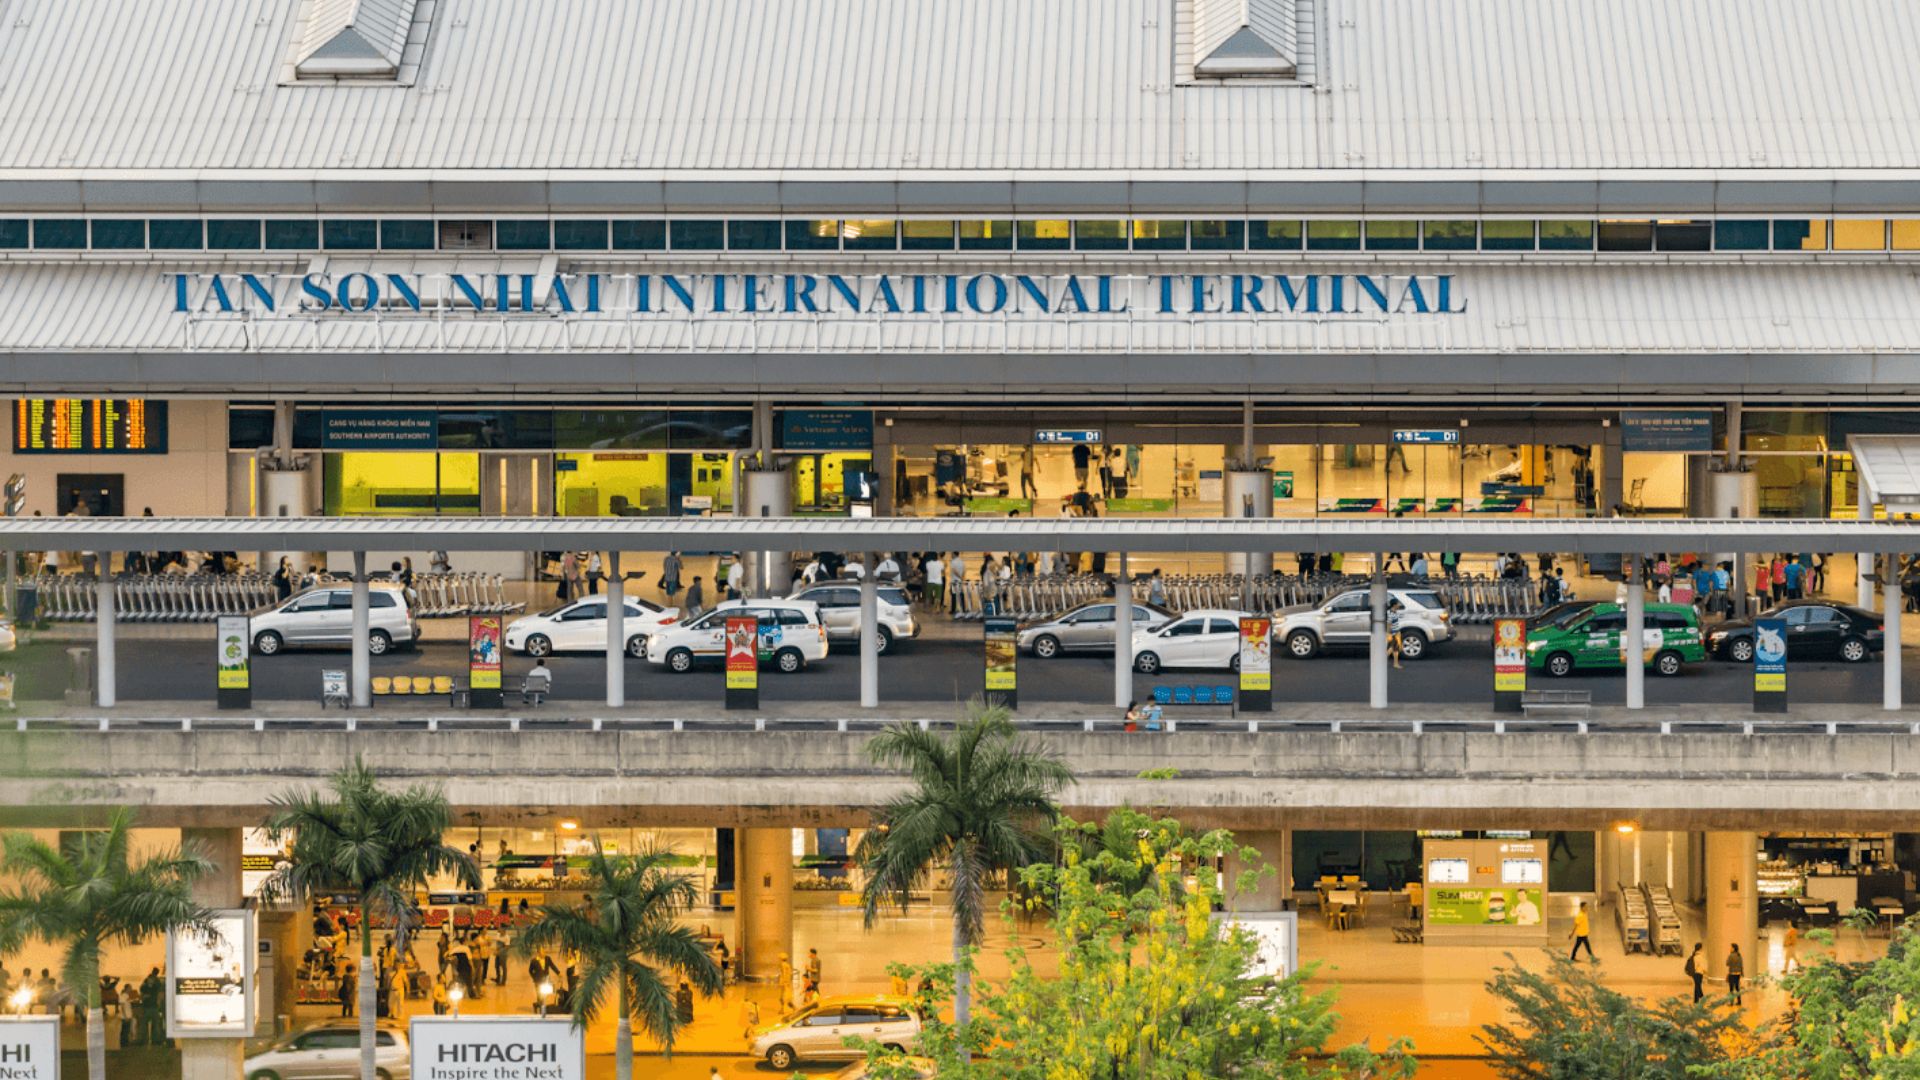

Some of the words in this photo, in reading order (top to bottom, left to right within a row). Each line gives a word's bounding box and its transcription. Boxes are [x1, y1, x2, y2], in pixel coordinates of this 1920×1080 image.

[163, 273, 279, 313] TAN
[302, 272, 424, 313] SON
[447, 273, 614, 313] NHAT
[632, 273, 1130, 314] INTERNATIONAL
[1148, 274, 1467, 314] TERMINAL
[329, 432, 363, 440] SOUTHERN
[364, 432, 394, 440] AIRPORTS
[396, 432, 431, 440] AUTHORITY
[1086, 431, 1099, 441] D1
[1444, 431, 1456, 441] D1
[438, 1043, 557, 1063] HITACHI
[431, 1066, 488, 1080] Inspire
[494, 1066, 519, 1079] the
[526, 1066, 563, 1079] Next
